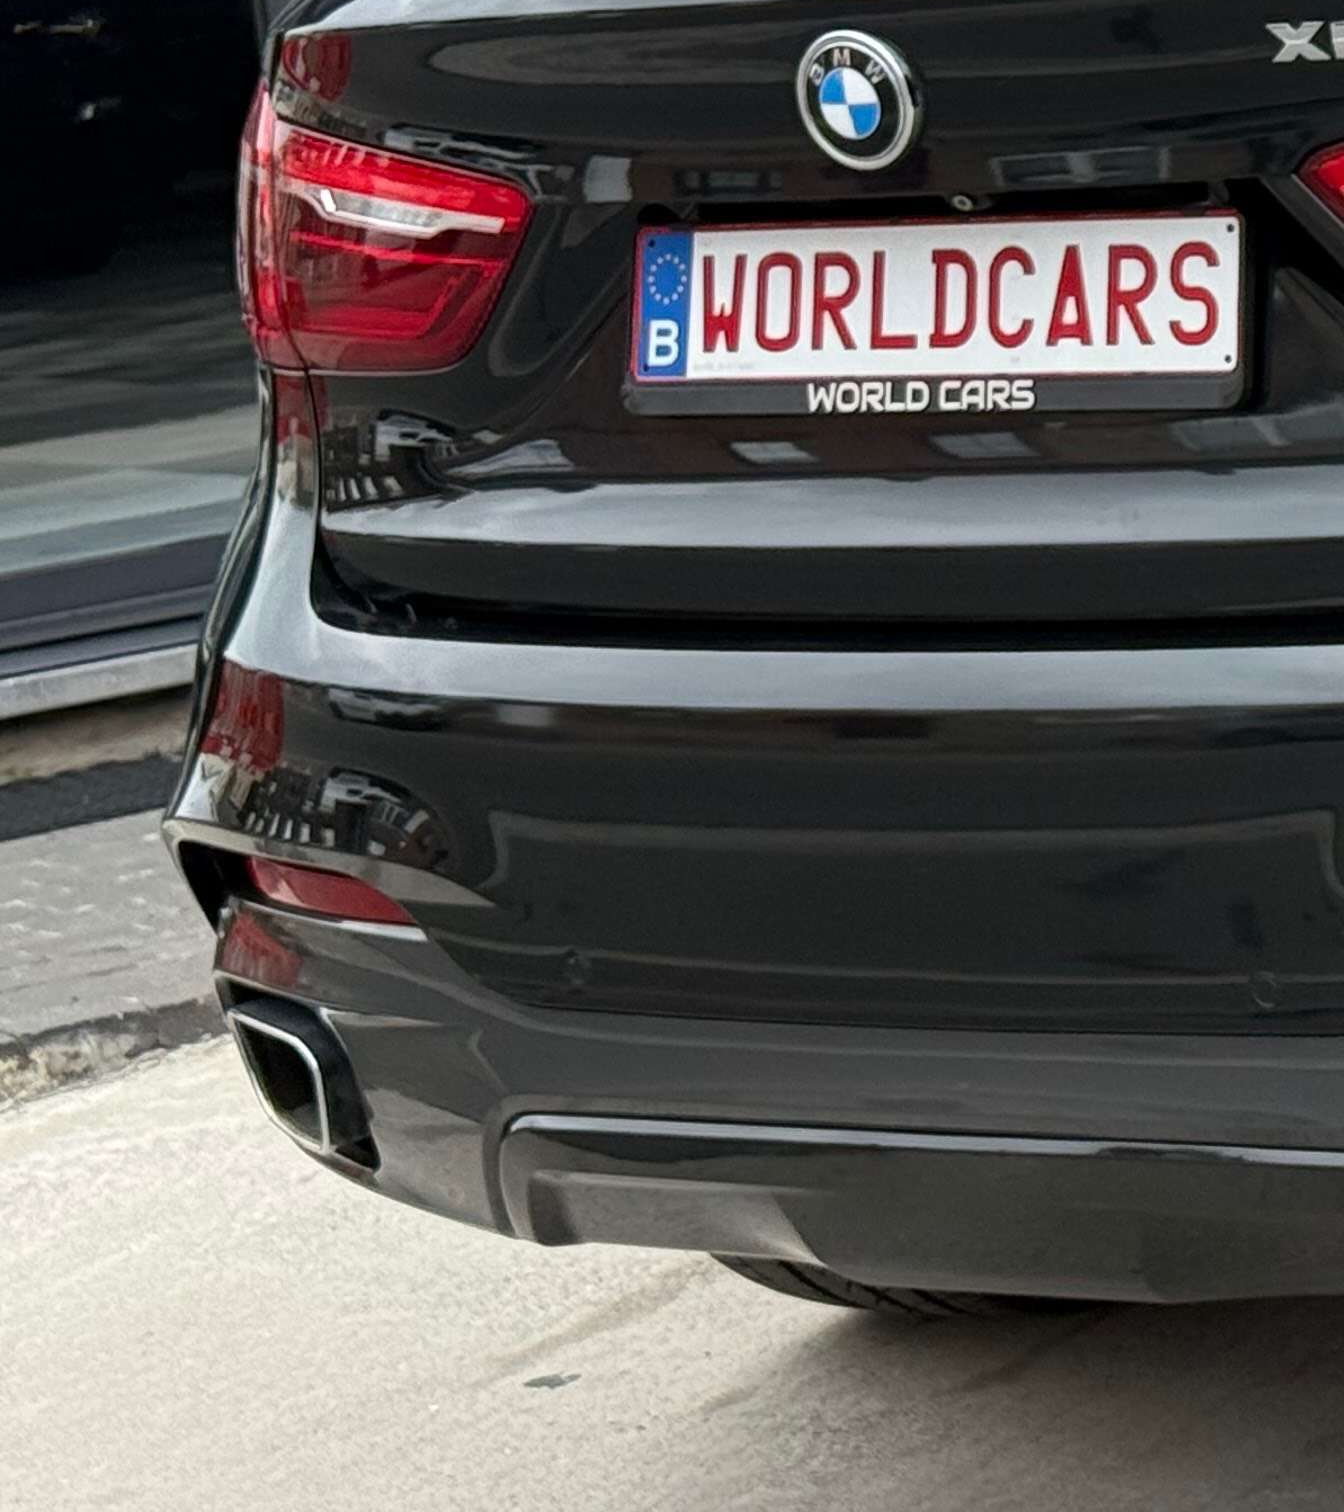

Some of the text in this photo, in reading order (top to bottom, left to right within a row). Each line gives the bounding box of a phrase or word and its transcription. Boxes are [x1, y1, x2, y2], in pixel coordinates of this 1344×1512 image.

[808, 47, 889, 87] BMW
[647, 240, 1220, 366] B WORLDCARS
[806, 378, 1036, 414] WORLD CARS
